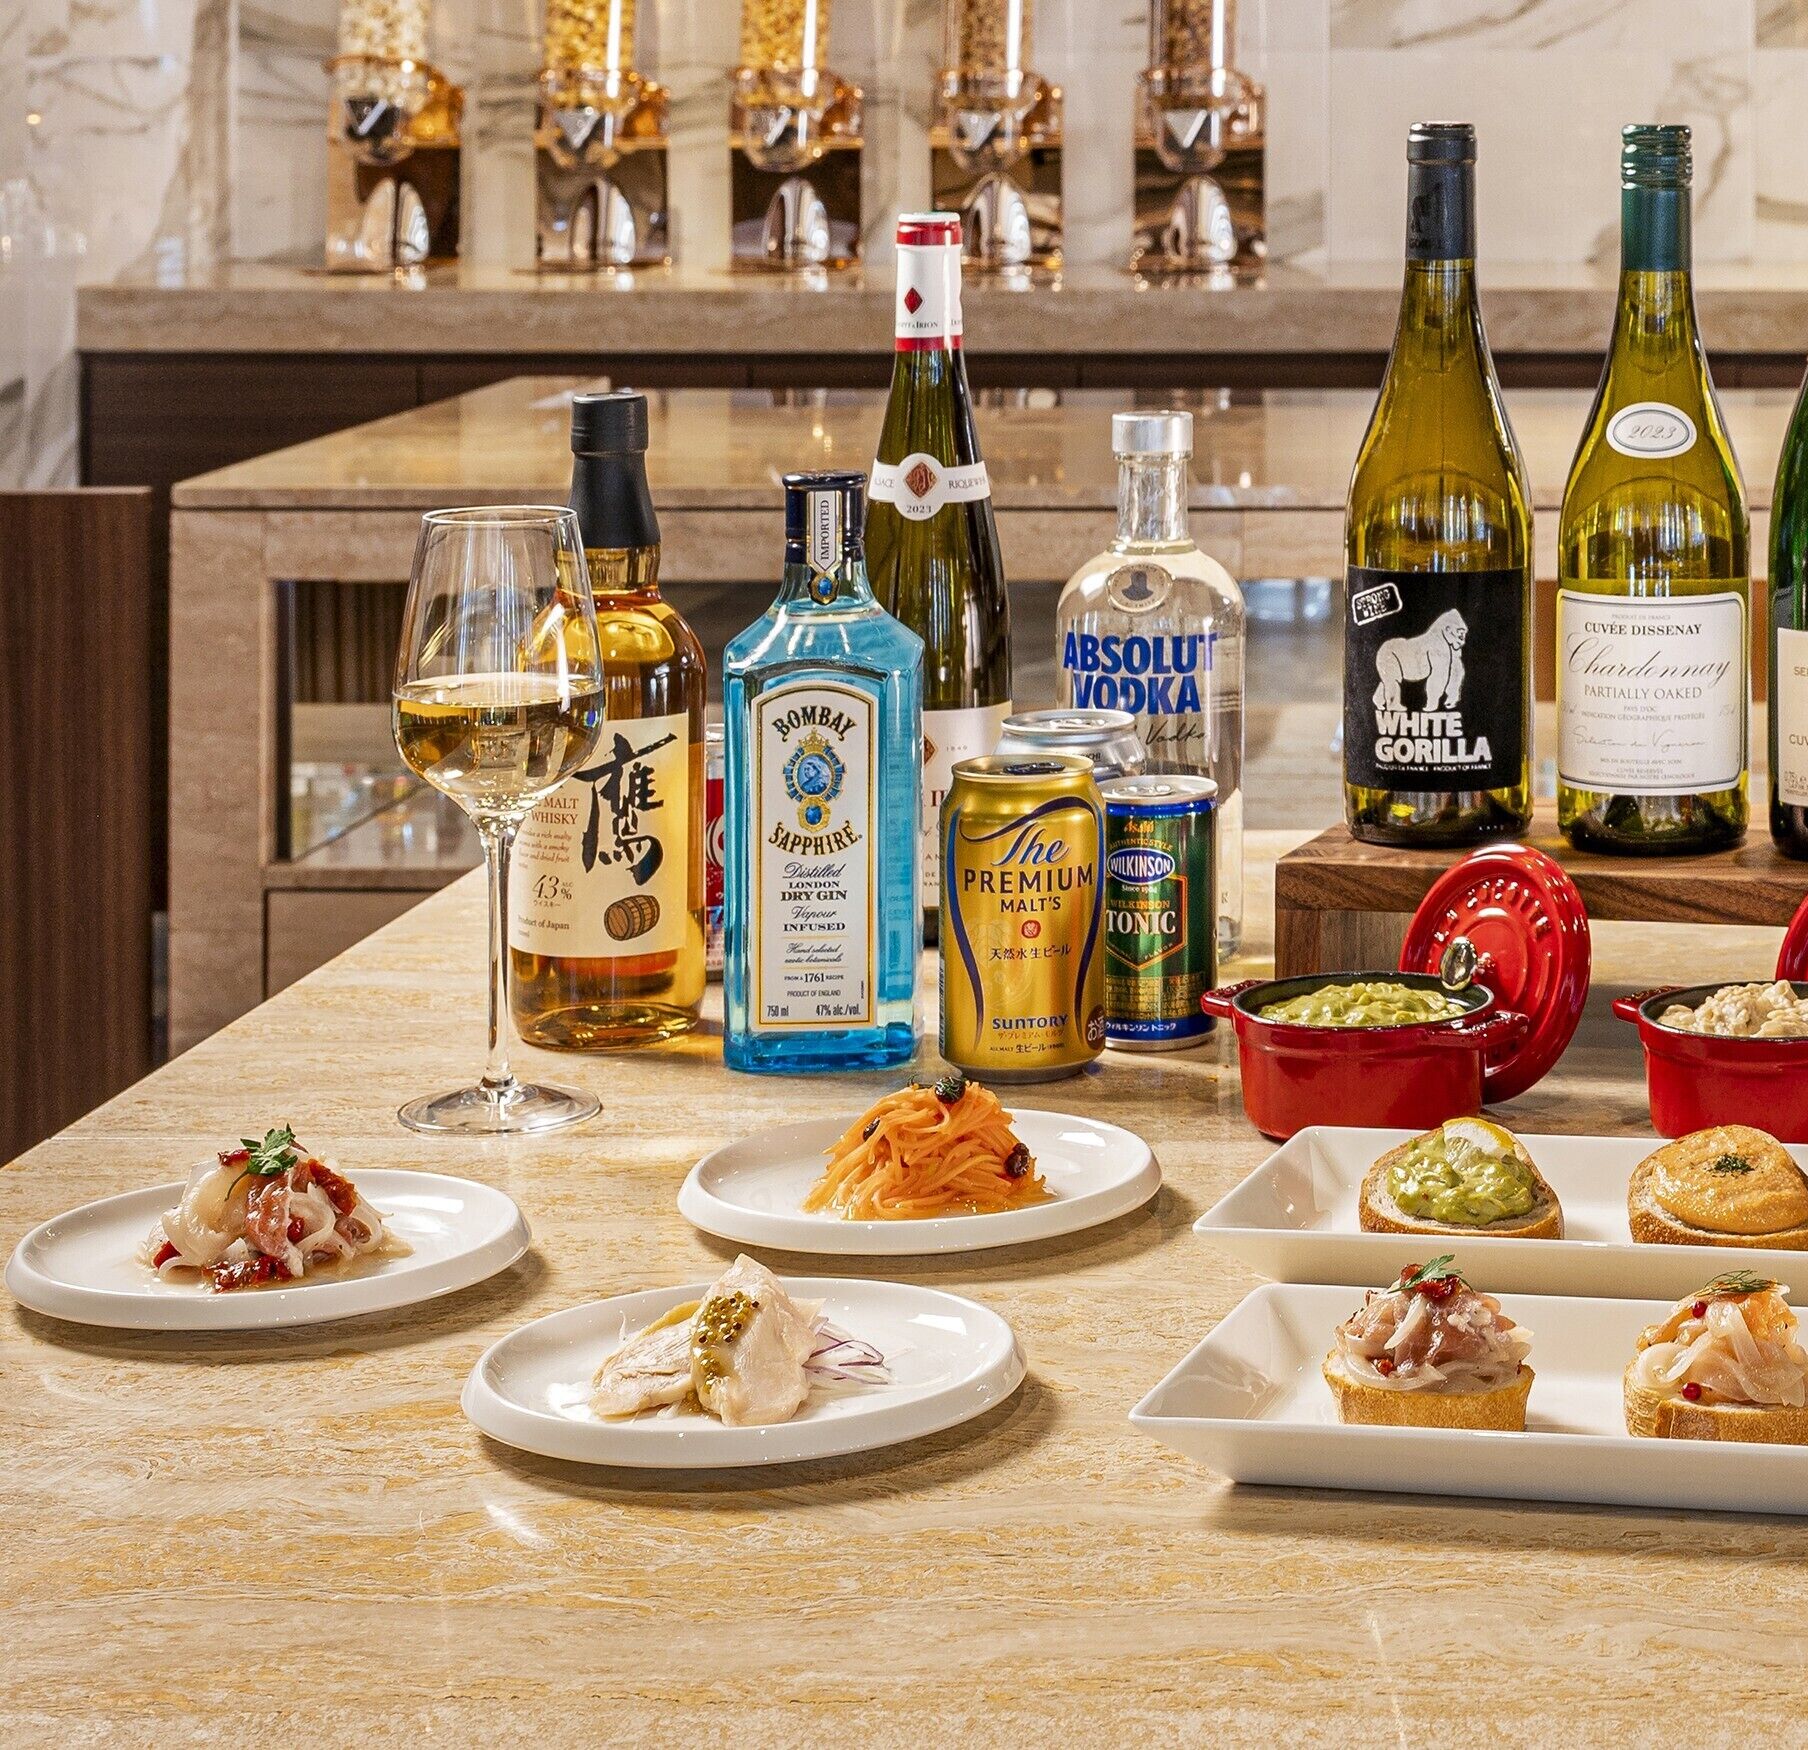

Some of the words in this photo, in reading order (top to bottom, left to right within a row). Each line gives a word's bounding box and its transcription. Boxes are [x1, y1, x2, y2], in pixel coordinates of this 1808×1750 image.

[916, 321, 938, 329] IRION
[1628, 425, 1677, 439] 2023
[906, 505, 932, 514] 2023
[820, 500, 830, 560] IMPORTED
[1356, 589, 1390, 610] STRONG
[1363, 605, 1387, 618] WINE
[1585, 620, 1626, 636] CUVÉE
[1631, 623, 1702, 636] DISSENAY
[1063, 631, 1218, 675] ABSOLUT
[1566, 631, 1731, 687] Chardonnay
[1073, 674, 1201, 716] VODKA
[1584, 685, 1650, 700] PARTIALLY
[1654, 686, 1702, 699] OAKED
[771, 705, 858, 743] BOMBAY
[1375, 710, 1463, 738] WHITE
[1145, 719, 1205, 745] Vodka
[1375, 736, 1492, 764] GORILLA
[544, 796, 579, 809] MALT
[572, 733, 678, 886] 鷹
[531, 810, 579, 825] WHISKY
[768, 820, 859, 856] SAPPHIRE
[991, 821, 1072, 867] The
[1108, 838, 1149, 851] AUTHENTIC
[1149, 838, 1173, 852] STYLE
[782, 861, 847, 879] Distilled
[1110, 856, 1171, 878] WILKINSON
[789, 880, 840, 889] LONDON
[963, 862, 1094, 894] PREMIUM
[781, 890, 815, 902] DRY
[816, 889, 848, 901] GIN
[1121, 884, 1140, 893] Since
[1000, 896, 1061, 913] MALT'S
[1110, 900, 1171, 910] WILKINSON
[791, 905, 837, 923] Vapour
[538, 919, 545, 928] of
[546, 920, 570, 931] Japan
[783, 923, 846, 932] INFUSED
[1105, 909, 1176, 935] TONIC
[786, 943, 813, 953] Hand
[811, 943, 842, 953] selected
[989, 943, 1071, 961] 天然水生ビール
[805, 953, 844, 963] botanicals
[804, 973, 825, 983] 1761
[818, 989, 842, 997] ENGLAND
[767, 1005, 780, 1017] 750
[780, 1005, 789, 1017] ml
[816, 1004, 831, 1016] 47%
[992, 1014, 1069, 1030] SUNTORY
[1151, 1022, 1177, 1032] トニック
[1016, 1043, 1046, 1053] 生ビール
